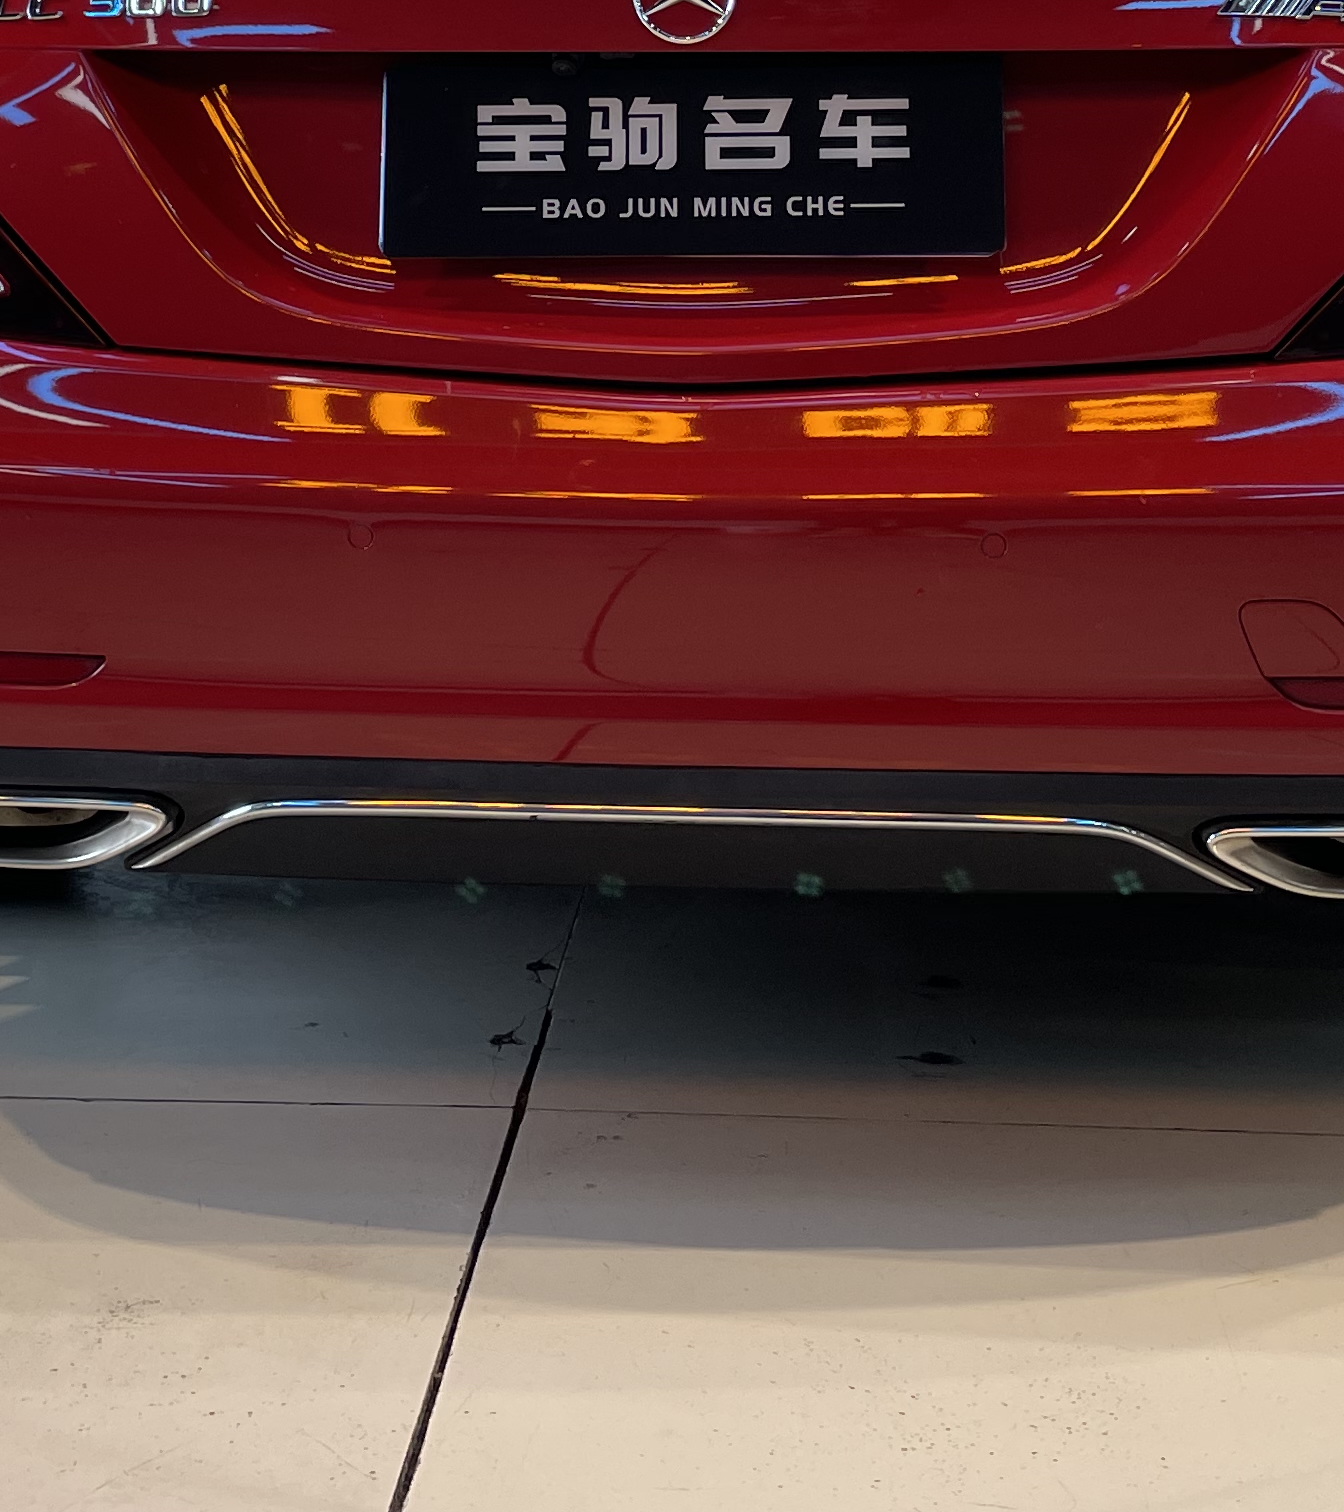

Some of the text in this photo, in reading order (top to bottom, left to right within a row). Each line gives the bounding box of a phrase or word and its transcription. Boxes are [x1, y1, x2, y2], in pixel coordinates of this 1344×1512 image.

[476, 93, 911, 172] 宝驹名车
[542, 194, 845, 219] BAO JUN MING CHE
